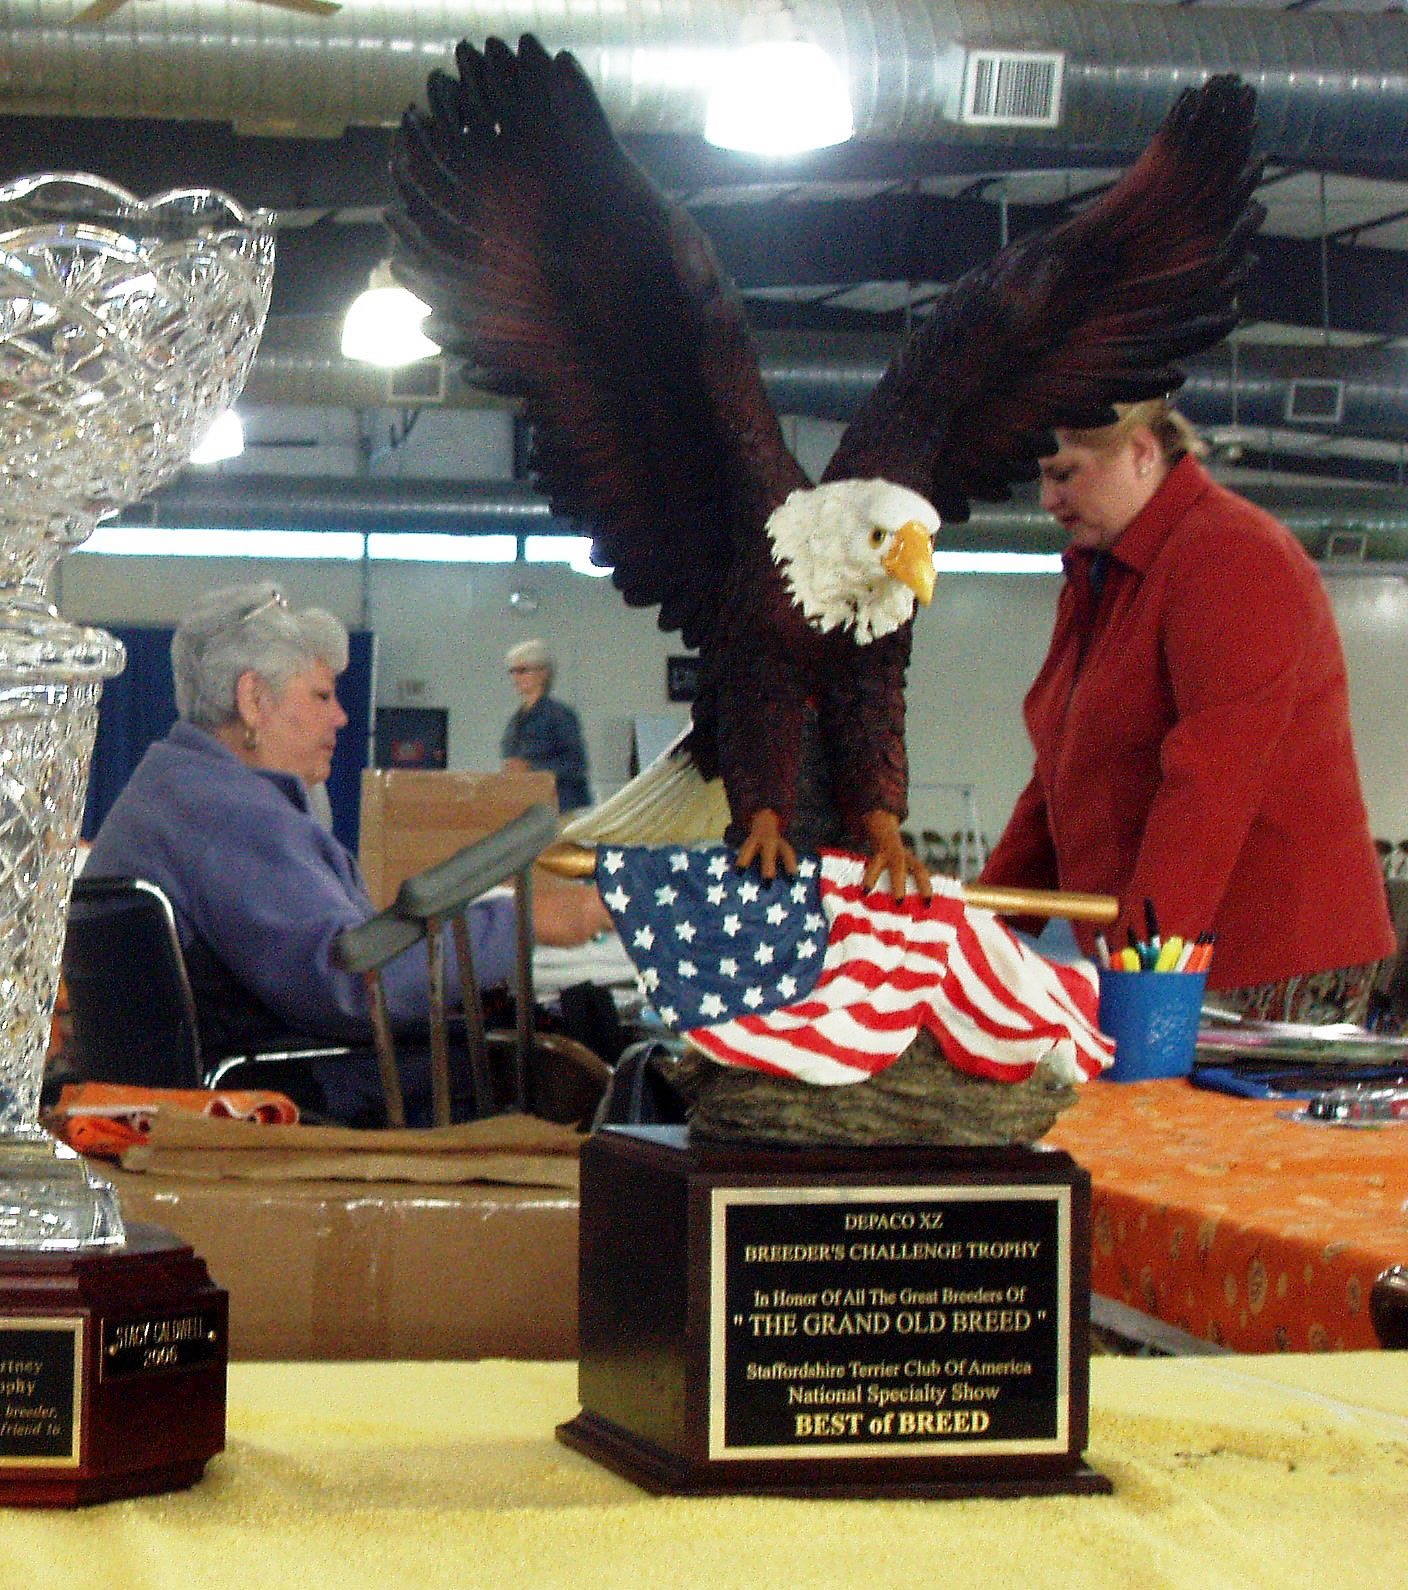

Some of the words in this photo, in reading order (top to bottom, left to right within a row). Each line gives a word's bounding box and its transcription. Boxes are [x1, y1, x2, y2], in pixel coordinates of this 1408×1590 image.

[845, 1212, 915, 1230] DEPACO
[920, 1211, 944, 1229] XZ
[744, 1243, 845, 1263] BREEDER'S
[849, 1242, 963, 1261] CHALLENGE
[966, 1241, 1041, 1259] TROPHY
[755, 1289, 769, 1307] In
[773, 1289, 818, 1307] Honor
[821, 1288, 843, 1306] Of
[843, 1287, 866, 1306] All
[869, 1287, 898, 1306] The
[900, 1287, 939, 1305] Great
[943, 1286, 1004, 1304] Breeders
[1006, 1284, 1028, 1303] Of
[116, 1321, 151, 1350] STACY
[153, 1316, 204, 1343] CALDWELL
[803, 1311, 891, 1336] GRAND
[896, 1310, 947, 1335] OLD
[746, 1360, 846, 1380] Staffordshire
[849, 1360, 901, 1378] Terrier
[904, 1359, 941, 1377] Club
[944, 1358, 968, 1376] Of
[968, 1358, 1033, 1376] America
[788, 1384, 863, 1405] National
[867, 1382, 947, 1408] Specialty
[951, 1381, 1001, 1401] Show
[0, 1420, 43, 1437] friend
[47, 1422, 62, 1436] to
[795, 1412, 865, 1437] BEST
[869, 1412, 896, 1436] of
[898, 1410, 991, 1435] BREED
